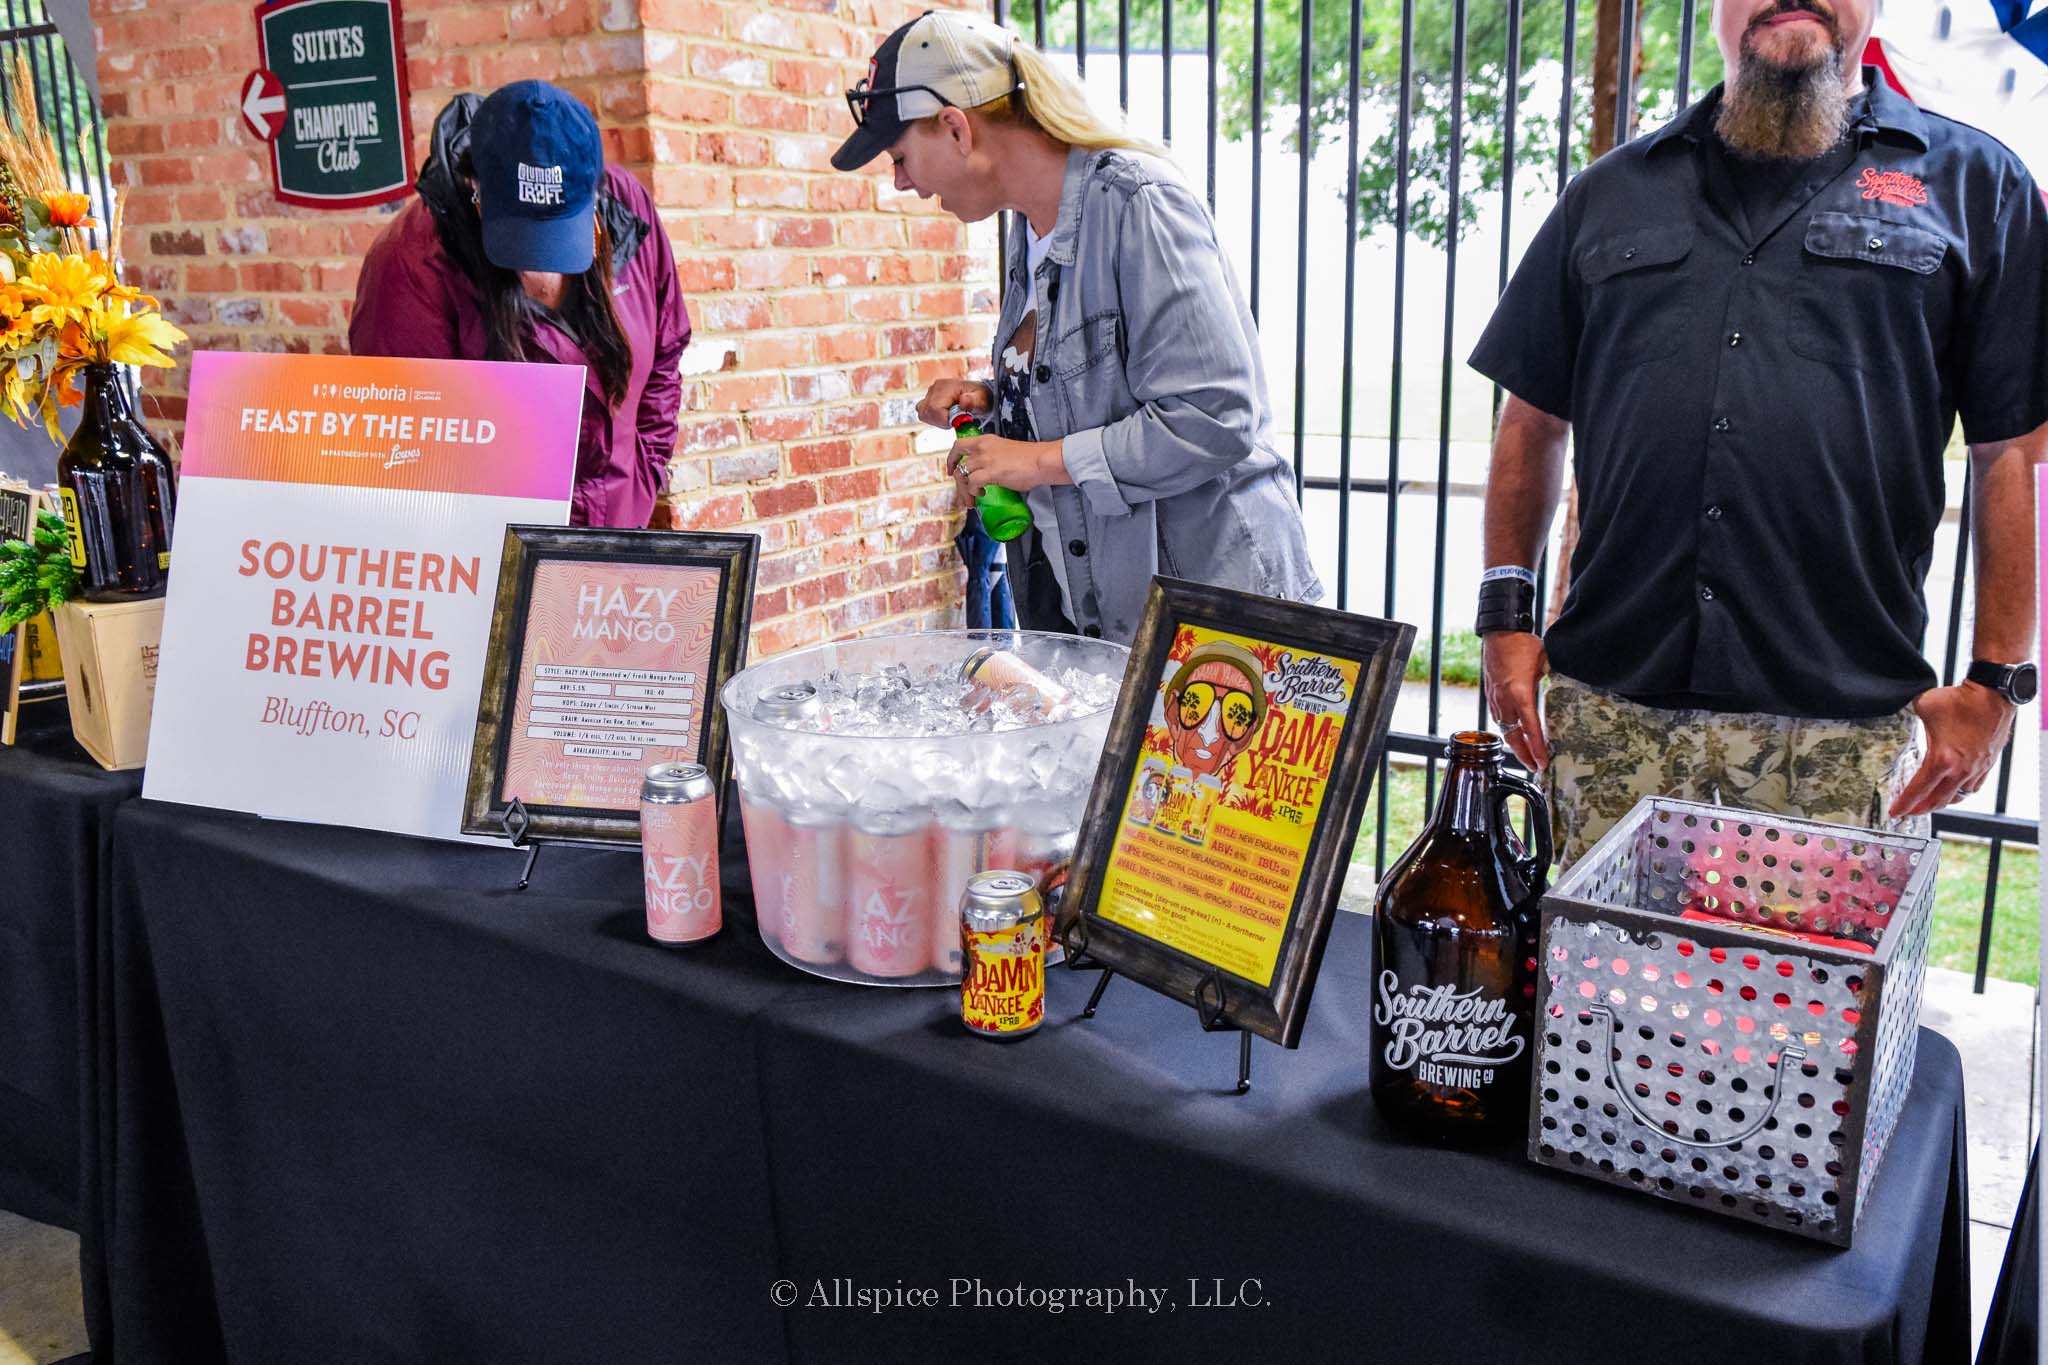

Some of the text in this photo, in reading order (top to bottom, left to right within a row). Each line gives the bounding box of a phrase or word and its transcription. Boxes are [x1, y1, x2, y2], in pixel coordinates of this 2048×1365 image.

[292, 25, 365, 64] SUITES
[293, 101, 379, 142] CHAMPIONS
[317, 135, 361, 173] Club
[343, 383, 407, 403] euphoria
[240, 408, 497, 444] FEAST BY THE FIELD
[238, 539, 481, 596] SOUTHERN
[271, 588, 434, 640] BARREL
[577, 583, 679, 620] HAZY
[571, 619, 676, 644] MANGO
[245, 633, 450, 690] BREWING
[1269, 651, 1342, 684] Southern
[1275, 676, 1346, 705] Barrel
[1293, 699, 1321, 714] BREWING
[260, 696, 421, 740] Bluffton, SC
[1259, 708, 1341, 778] DAMN
[1243, 749, 1320, 807] YANKEE
[1211, 839, 1233, 856] ABV:
[644, 852, 708, 890] AZY
[646, 887, 714, 914] NGO
[974, 956, 1038, 993] DAMN
[969, 986, 1025, 1016] YANKEE
[1374, 969, 1507, 1026] Southern
[1384, 1013, 1526, 1071] Barrel
[1418, 1060, 1482, 1089] BREWING
